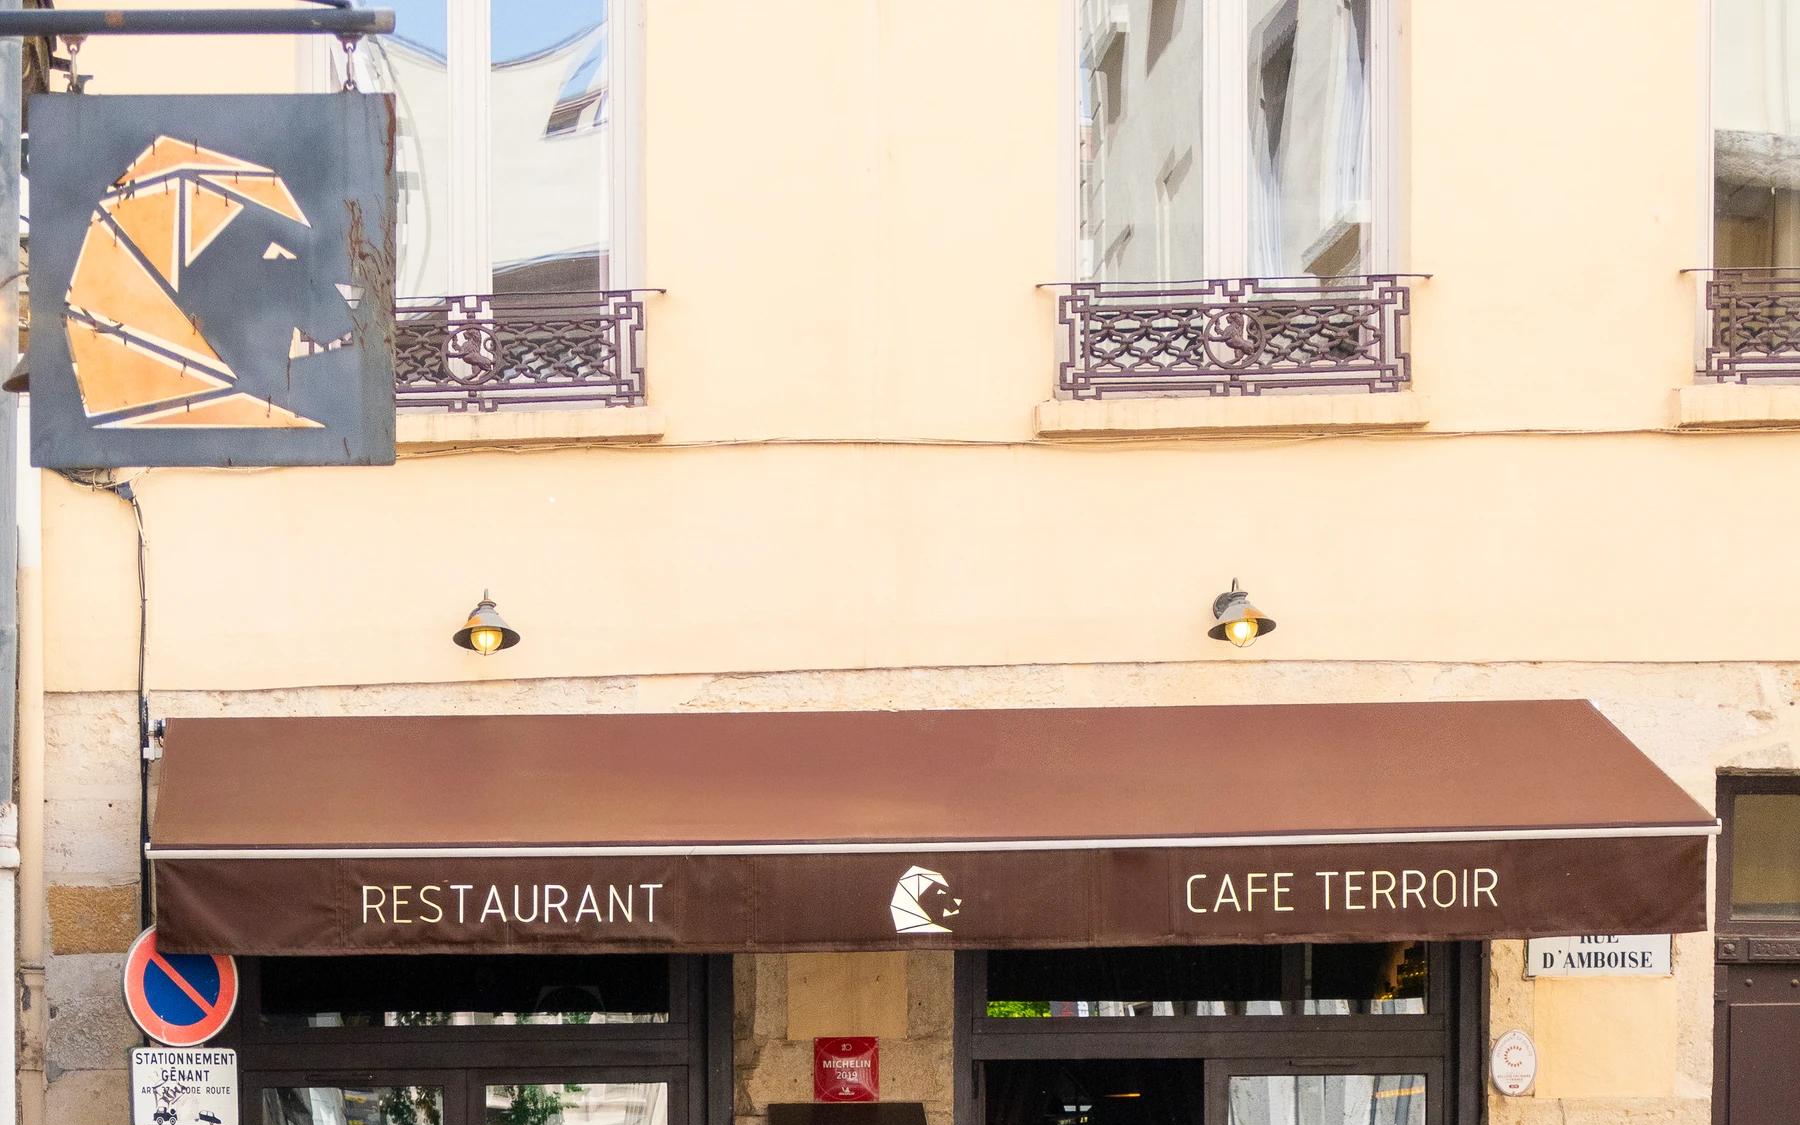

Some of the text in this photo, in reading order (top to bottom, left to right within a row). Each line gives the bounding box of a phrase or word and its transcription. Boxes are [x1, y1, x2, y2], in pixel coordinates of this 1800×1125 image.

[1186, 868, 1499, 913] CAFE TERROIR
[362, 884, 664, 923] RESTAURANT
[1542, 950, 1653, 969] D'AMBOISE
[135, 1052, 235, 1065] STATIONNEMENT
[822, 1060, 871, 1069] MICHELIN
[161, 1066, 210, 1082] GÊNANT
[836, 1071, 858, 1079] 2019
[181, 1086, 200, 1095] CODE
[206, 1086, 231, 1095] ROUTE
